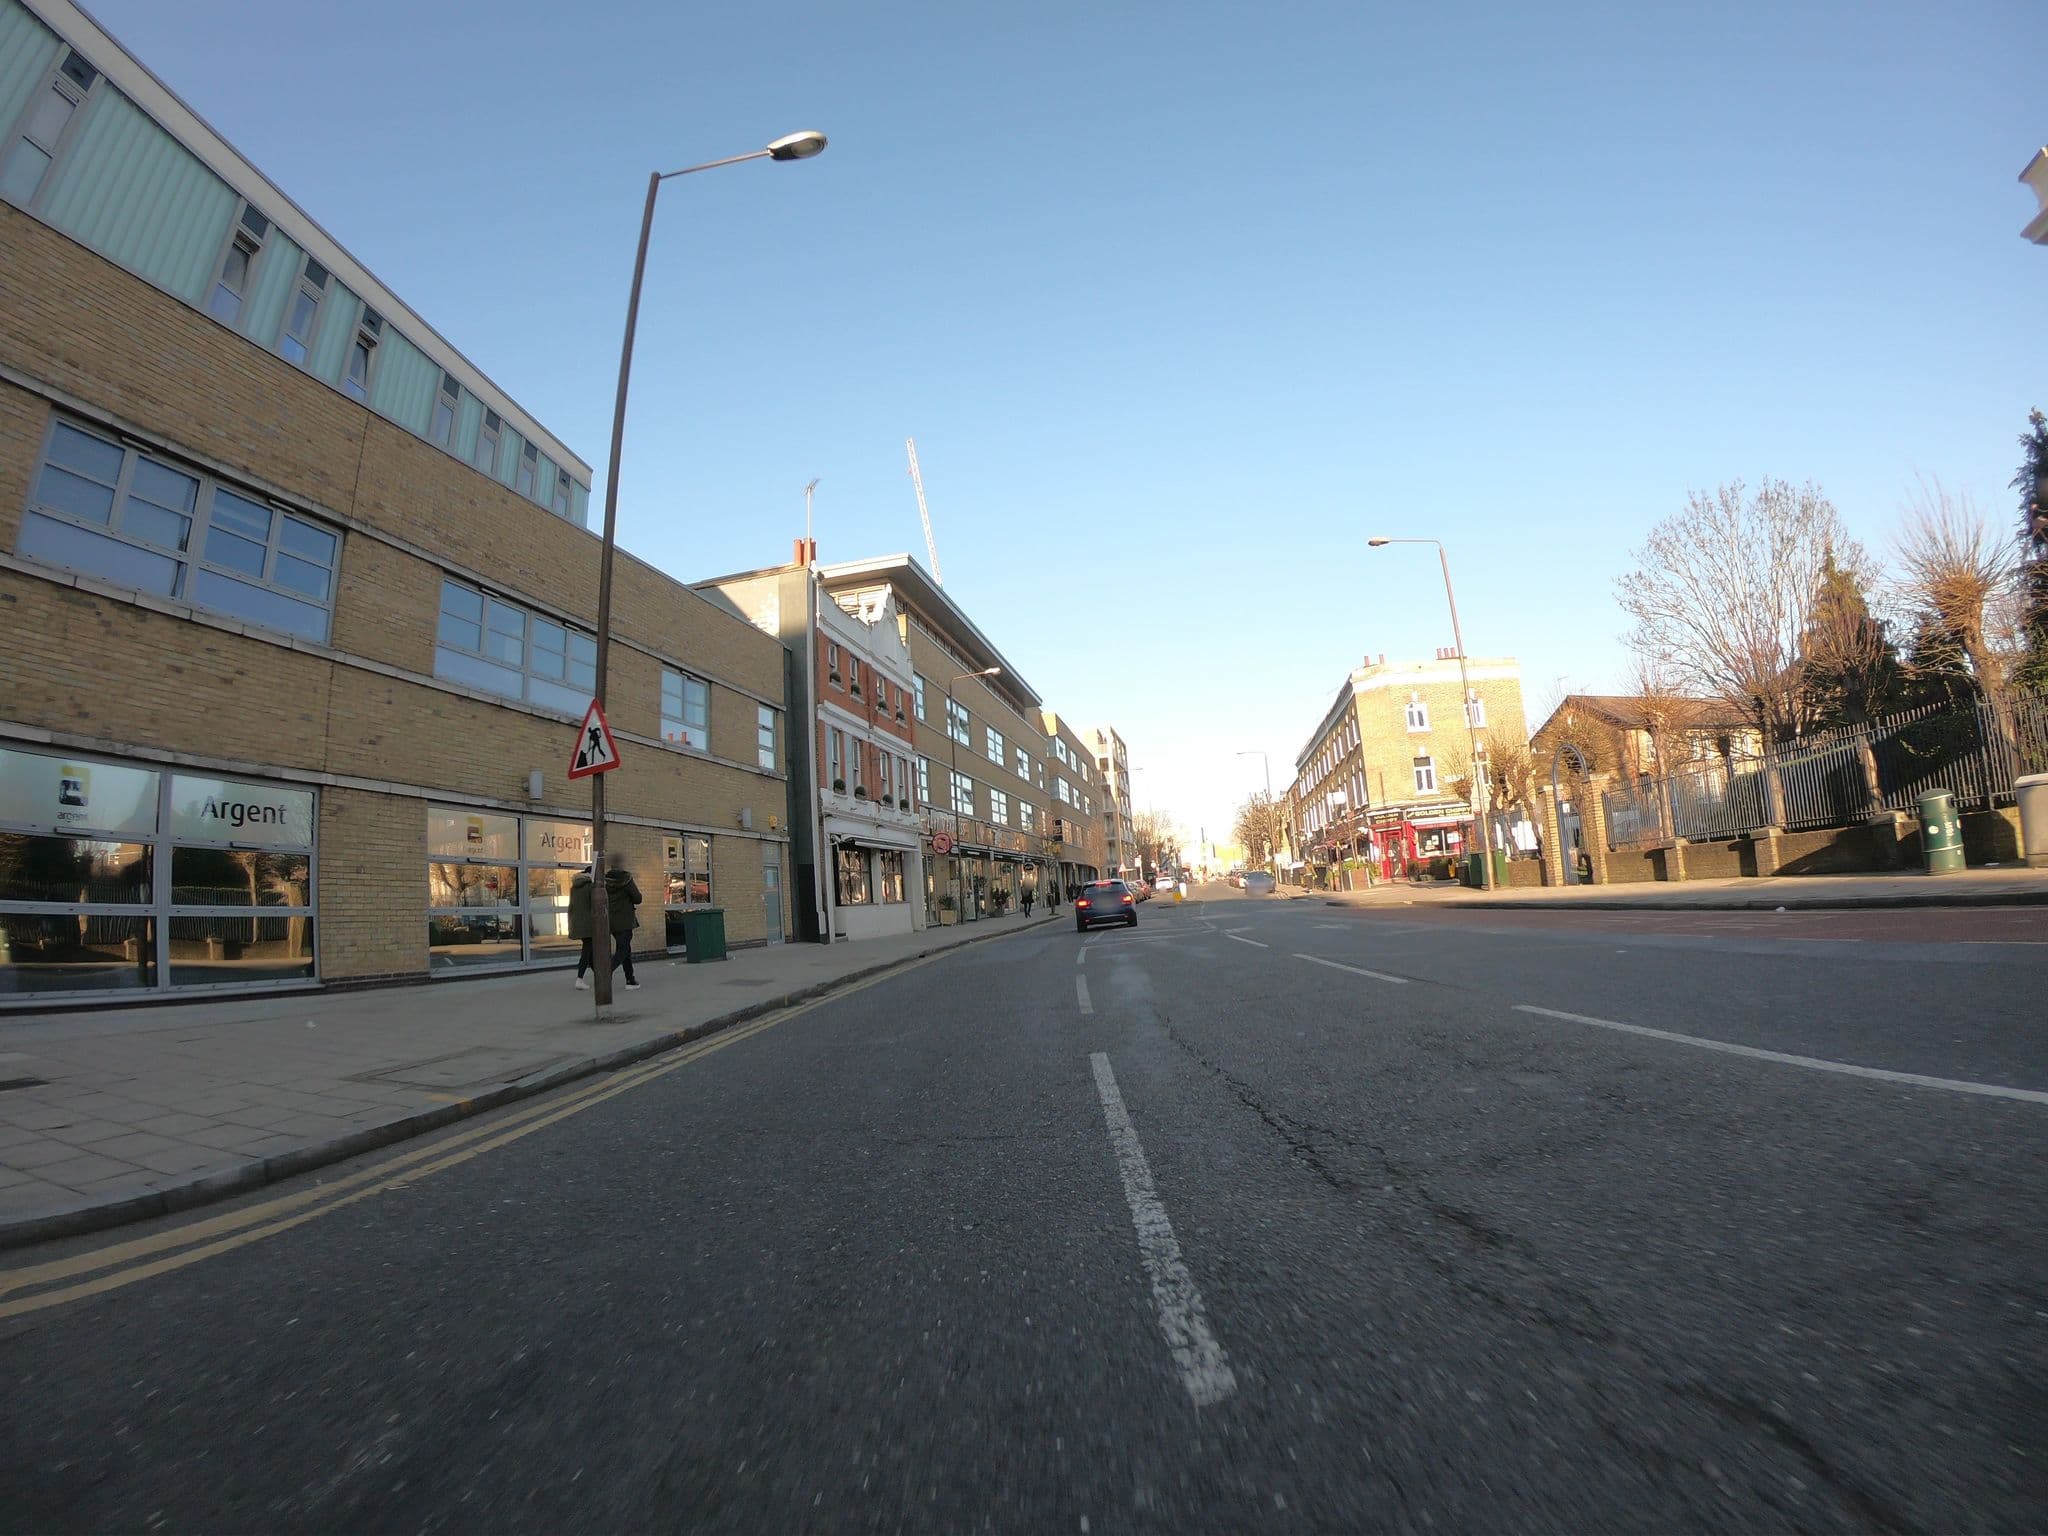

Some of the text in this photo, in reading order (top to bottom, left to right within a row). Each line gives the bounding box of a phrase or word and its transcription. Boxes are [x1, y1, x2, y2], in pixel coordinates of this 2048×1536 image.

[57, 811, 88, 823] arge
[201, 796, 287, 827] Argent
[541, 832, 588, 853] Argen
